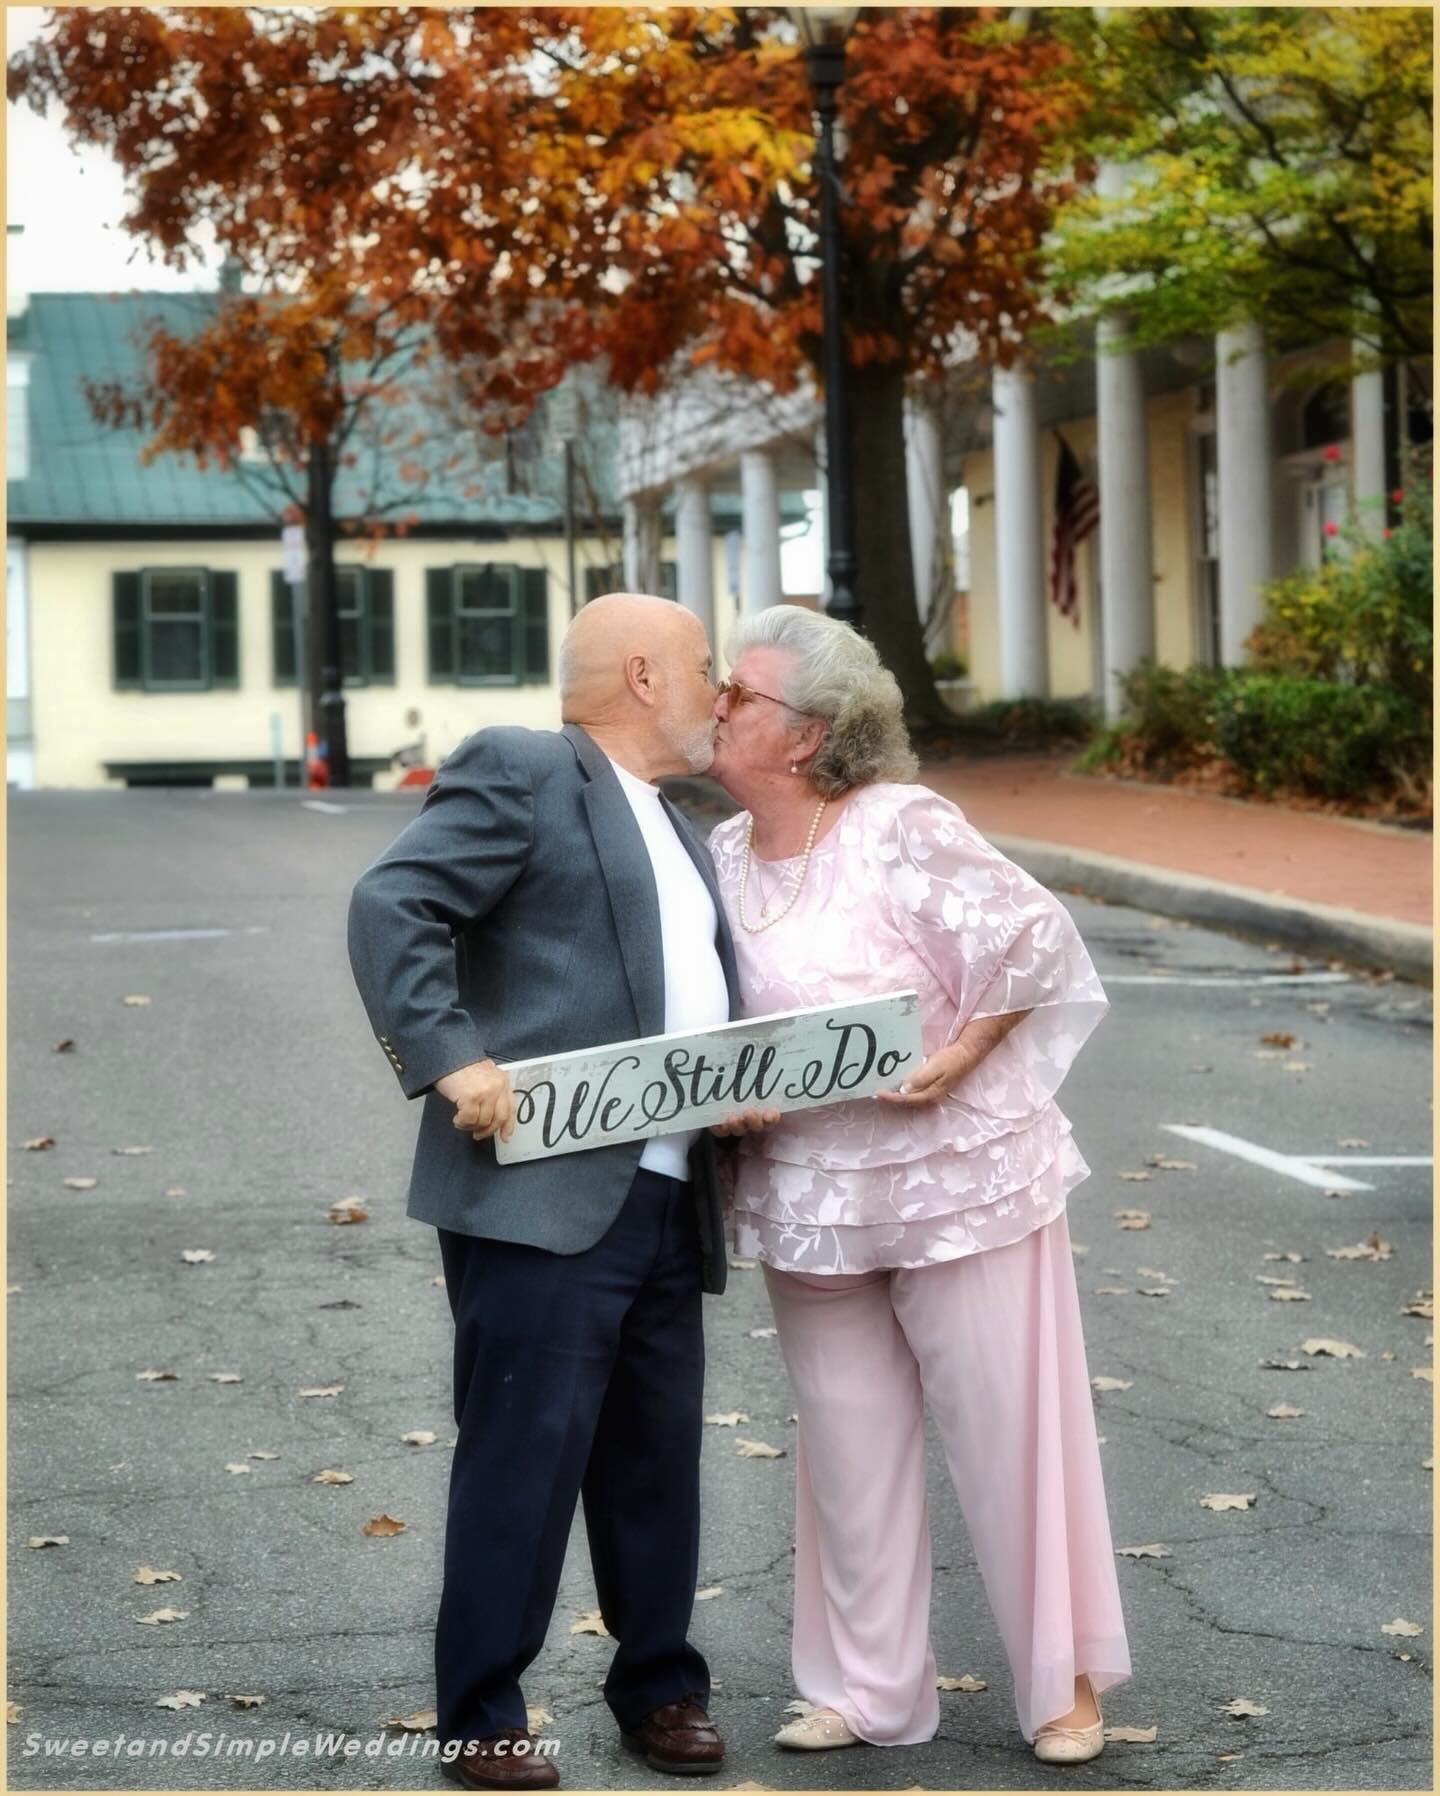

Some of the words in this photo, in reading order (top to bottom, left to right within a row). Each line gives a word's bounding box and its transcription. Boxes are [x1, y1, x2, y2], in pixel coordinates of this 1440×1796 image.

[512, 1056, 640, 1148] We
[634, 1044, 783, 1131] Still
[784, 1018, 912, 1098] Do
